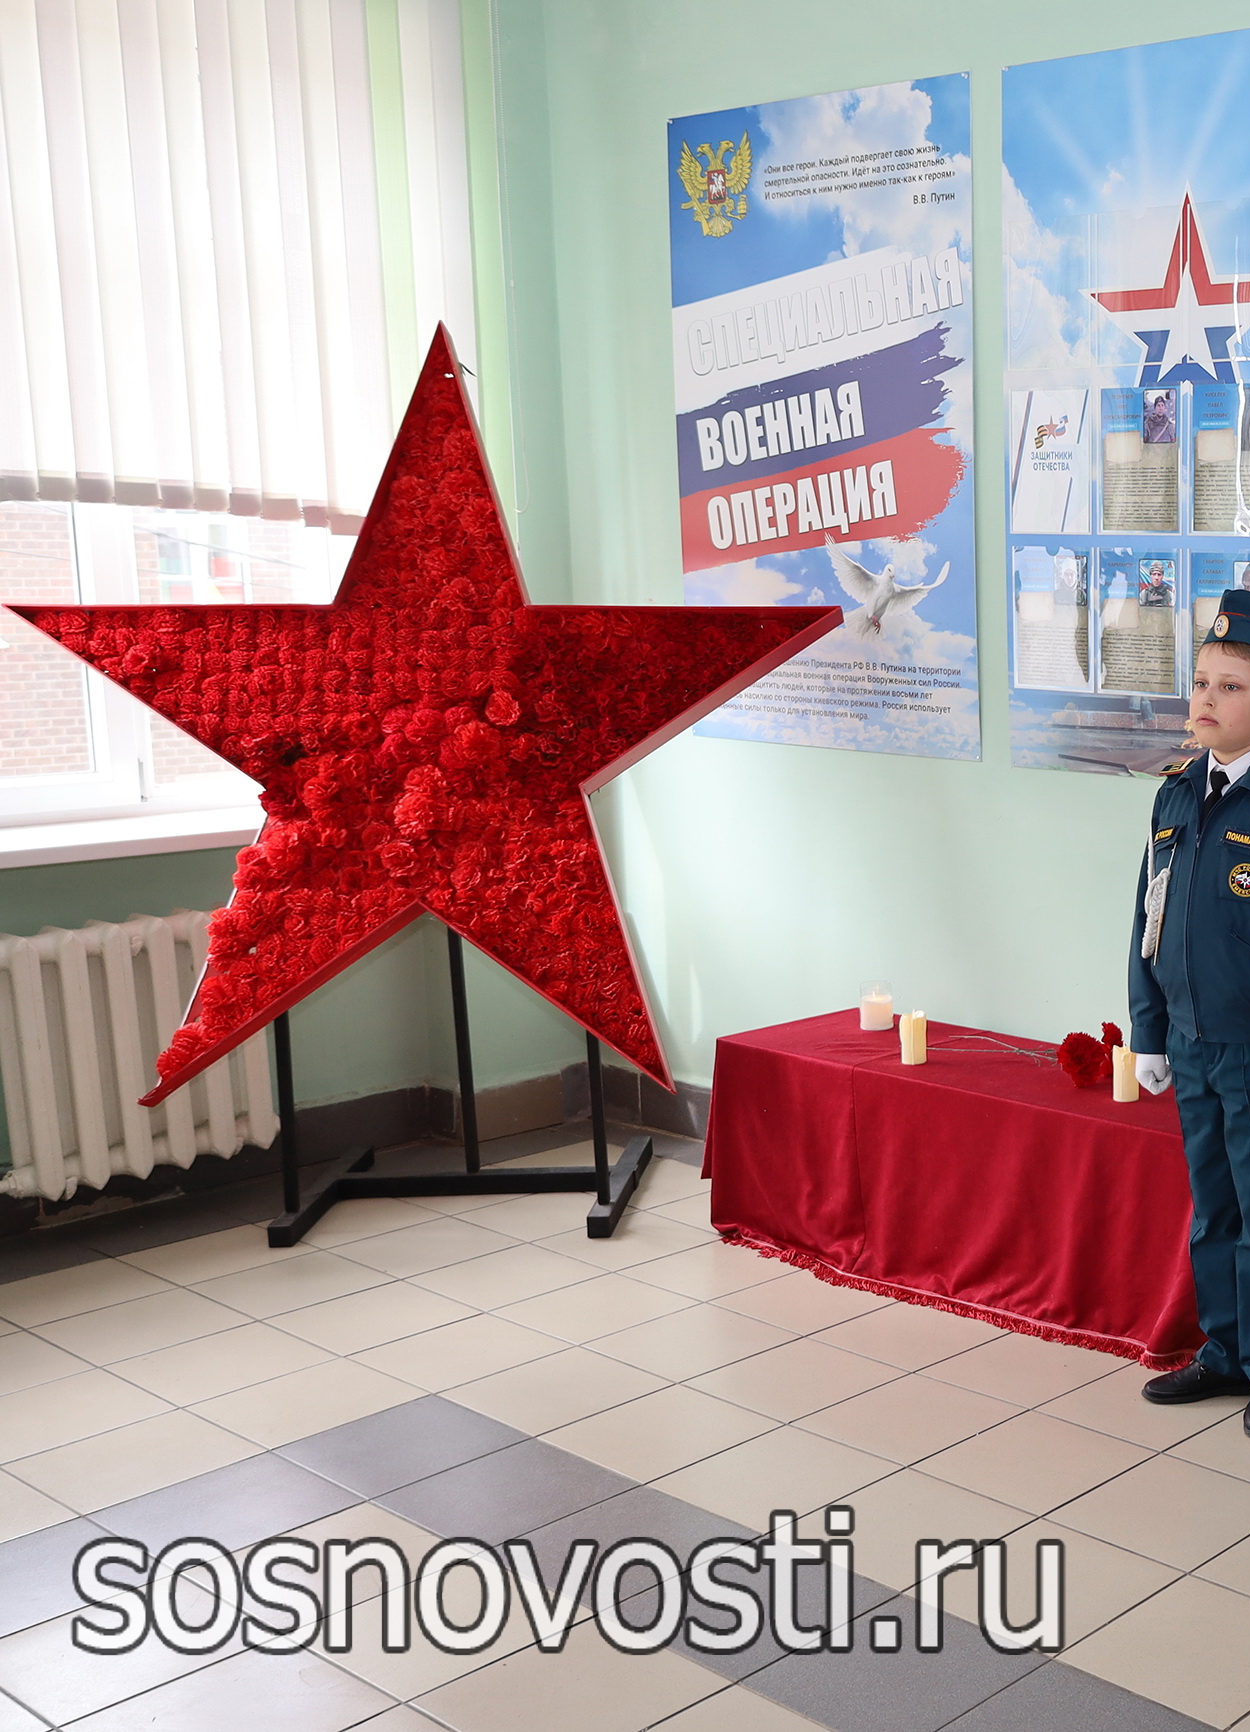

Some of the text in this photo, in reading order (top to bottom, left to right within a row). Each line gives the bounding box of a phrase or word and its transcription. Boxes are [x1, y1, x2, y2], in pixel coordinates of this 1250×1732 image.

[764, 145, 940, 175] «Они все герои. Каждый подвергает свою жизнь
[764, 157, 947, 188] смертельной опасности. Идёт на это сознательно.
[765, 191, 770, 200] И
[772, 186, 811, 199] относиться
[818, 185, 833, 194] ним
[834, 182, 858, 194] нужно
[859, 179, 887, 189] именно
[888, 175, 916, 186] так-как
[918, 174, 923, 182] к
[924, 170, 956, 182] героям»
[913, 191, 955, 205] В.В. Путин
[687, 246, 964, 376] СПЕЦИАЛЬНАЯ
[696, 380, 865, 472] ВОЕННАЯ
[1031, 451, 1073, 462] ЗАЩИТНИКИ
[1033, 462, 1070, 471] ОТЕЧЕСТВА
[707, 459, 898, 550] ОПЕРАЦИЯ
[811, 659, 851, 670] Президента
[853, 661, 864, 670] РФ
[866, 662, 879, 671] В.В.
[881, 662, 906, 673] Путина
[918, 666, 961, 676] территории
[768, 671, 801, 679] циальная
[832, 674, 866, 683] операция
[867, 675, 917, 686] Вооруженных
[933, 679, 962, 689] России.
[781, 682, 805, 692] людей,
[806, 685, 835, 694] которые
[847, 687, 890, 697] протяжении
[892, 690, 919, 698] восьми
[744, 693, 773, 701] насилию
[784, 695, 812, 704] стороны
[814, 697, 849, 706] киевского
[850, 700, 880, 709] режима.
[882, 700, 907, 710] Россия
[909, 704, 951, 715] использует
[744, 704, 762, 712] силы
[787, 707, 800, 715] для
[801, 709, 848, 718] установления
[850, 711, 870, 721] мира.
